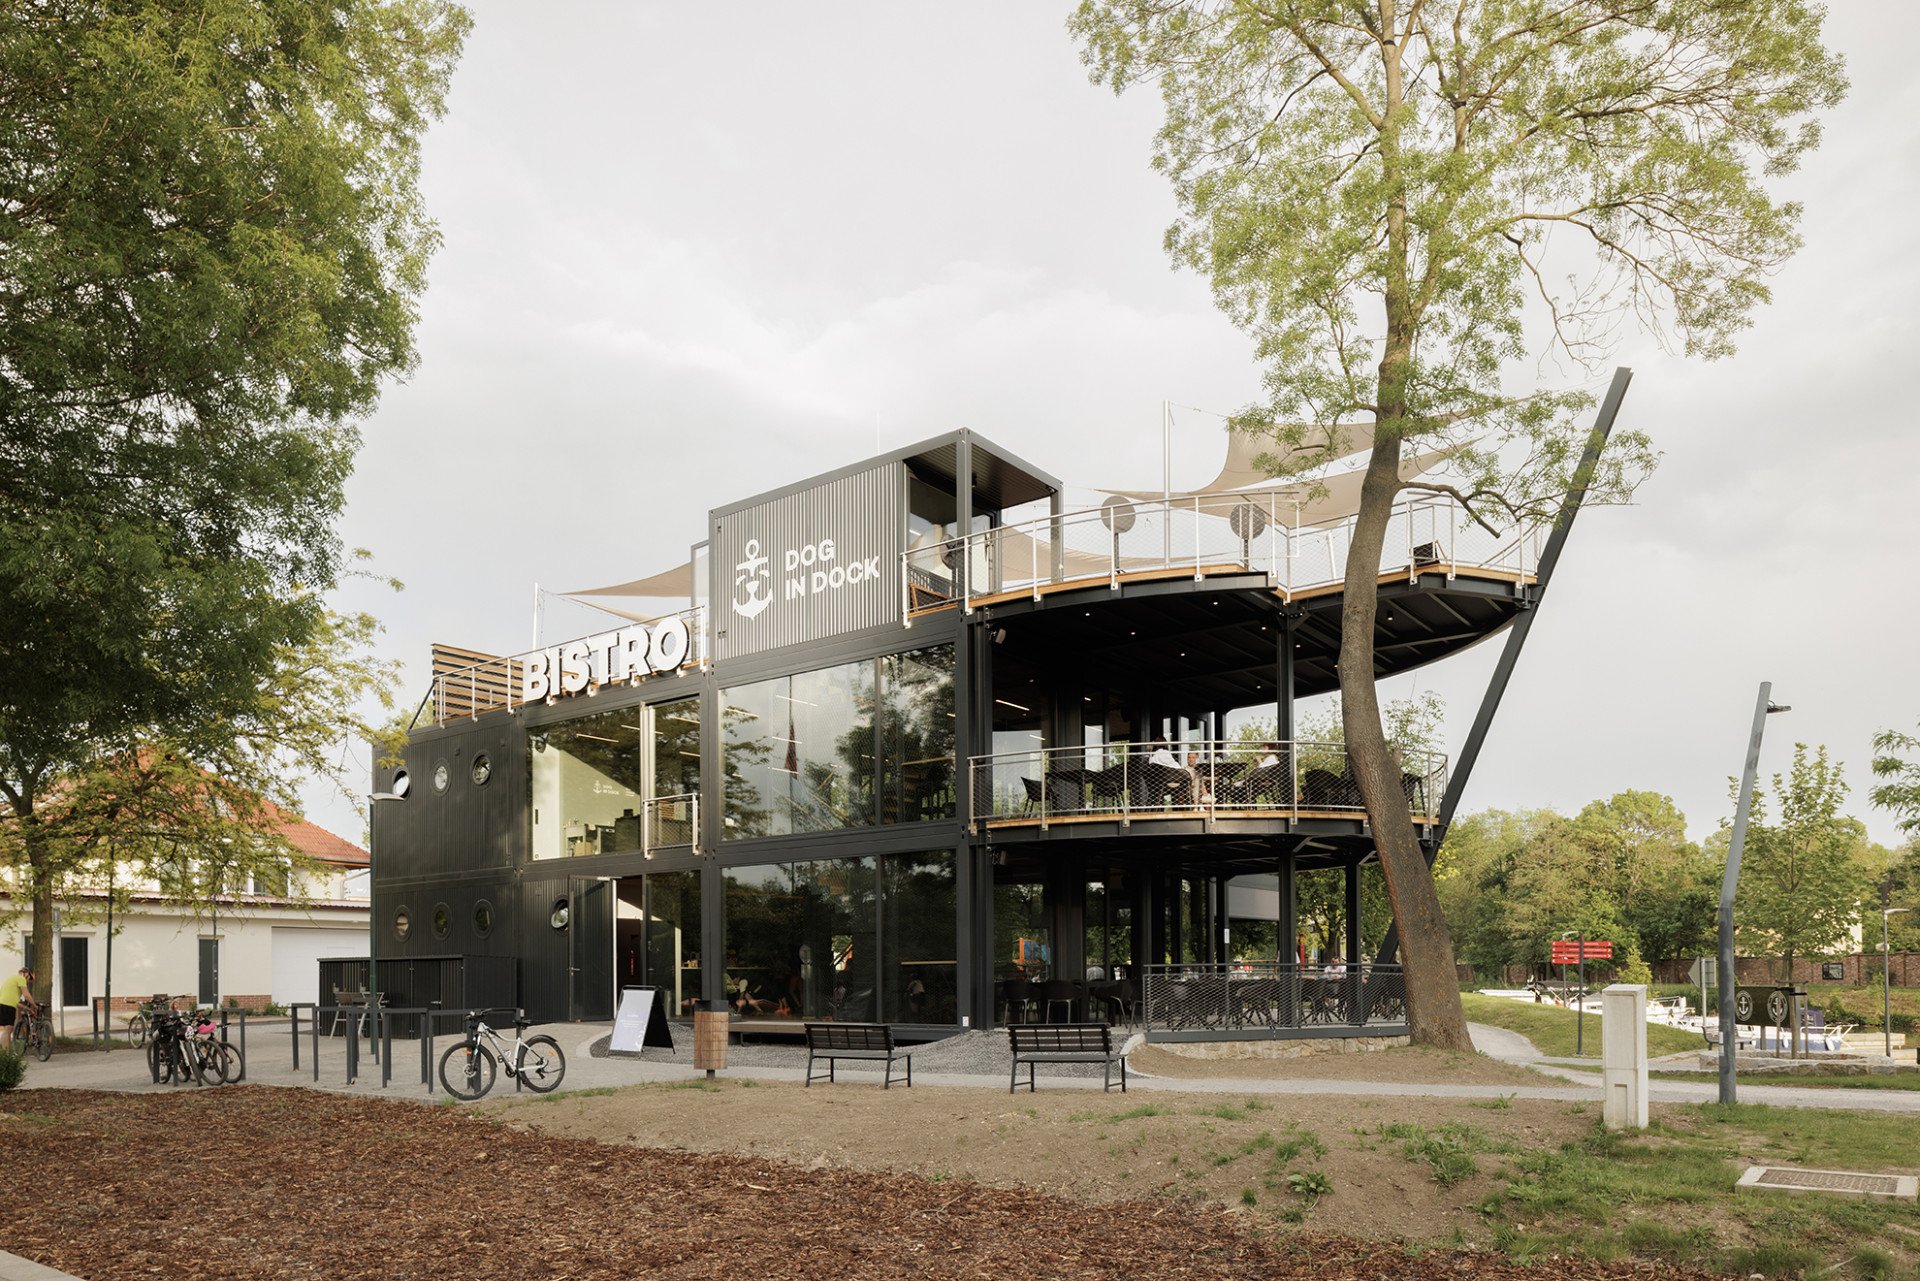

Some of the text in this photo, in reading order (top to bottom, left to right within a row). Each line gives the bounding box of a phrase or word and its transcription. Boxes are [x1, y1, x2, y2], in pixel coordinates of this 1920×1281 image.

[785, 539, 834, 572] DOG
[785, 556, 880, 600] IN DOCK
[522, 616, 689, 702] BISTRO
